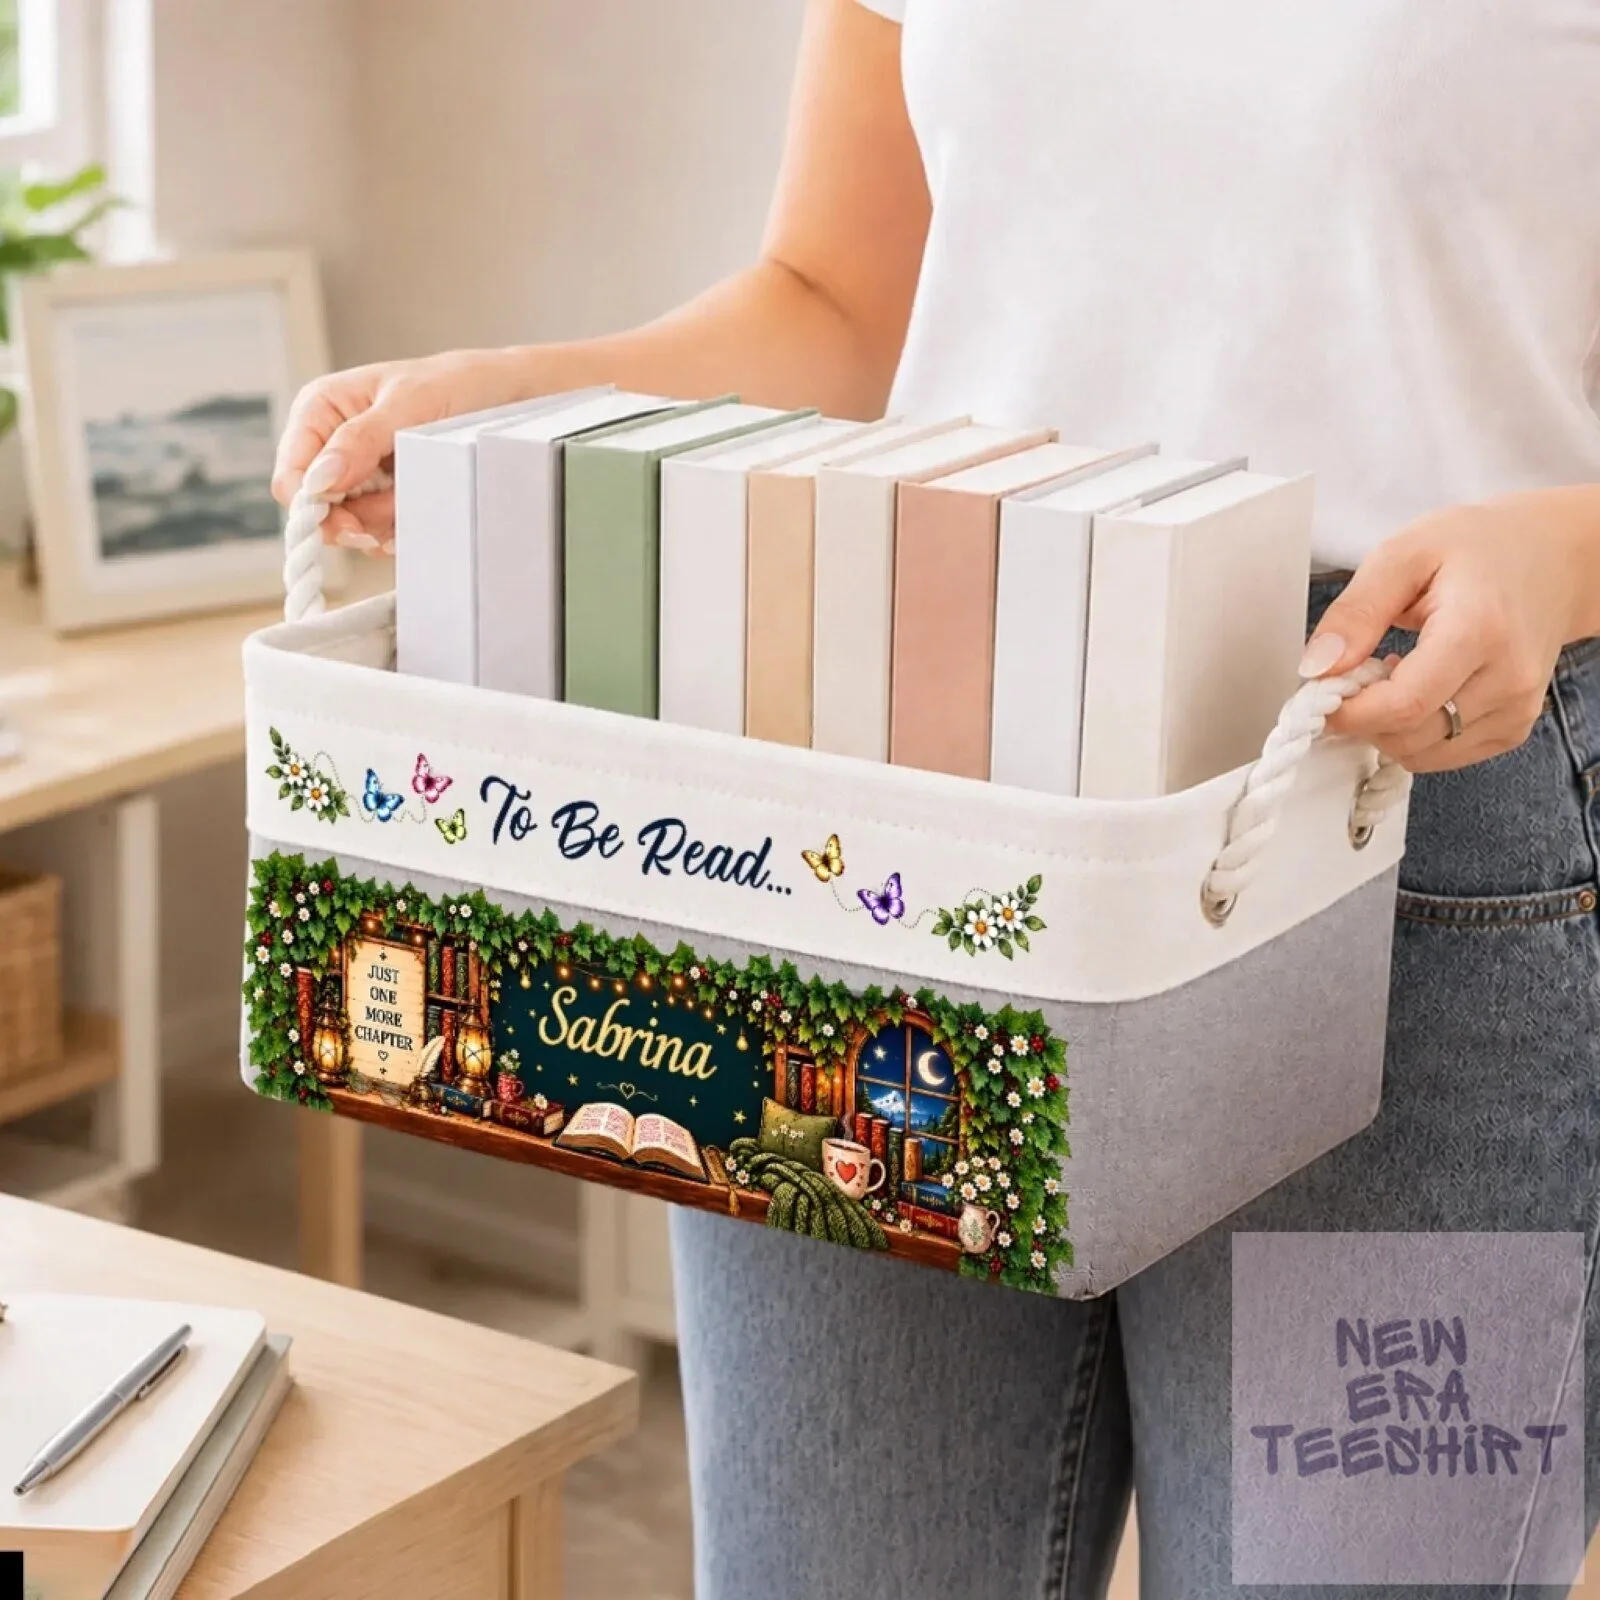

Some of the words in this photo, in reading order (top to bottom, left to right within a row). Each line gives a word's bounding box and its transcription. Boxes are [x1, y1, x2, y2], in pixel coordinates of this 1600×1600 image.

[480, 775, 537, 845] To
[551, 800, 624, 860] Be
[637, 818, 792, 895] Read...
[367, 965, 400, 984] JUST
[369, 986, 398, 1005] ONE
[365, 1006, 403, 1028] MORE
[354, 1024, 413, 1051] CHAPTER
[538, 986, 717, 1080] Sabrina
